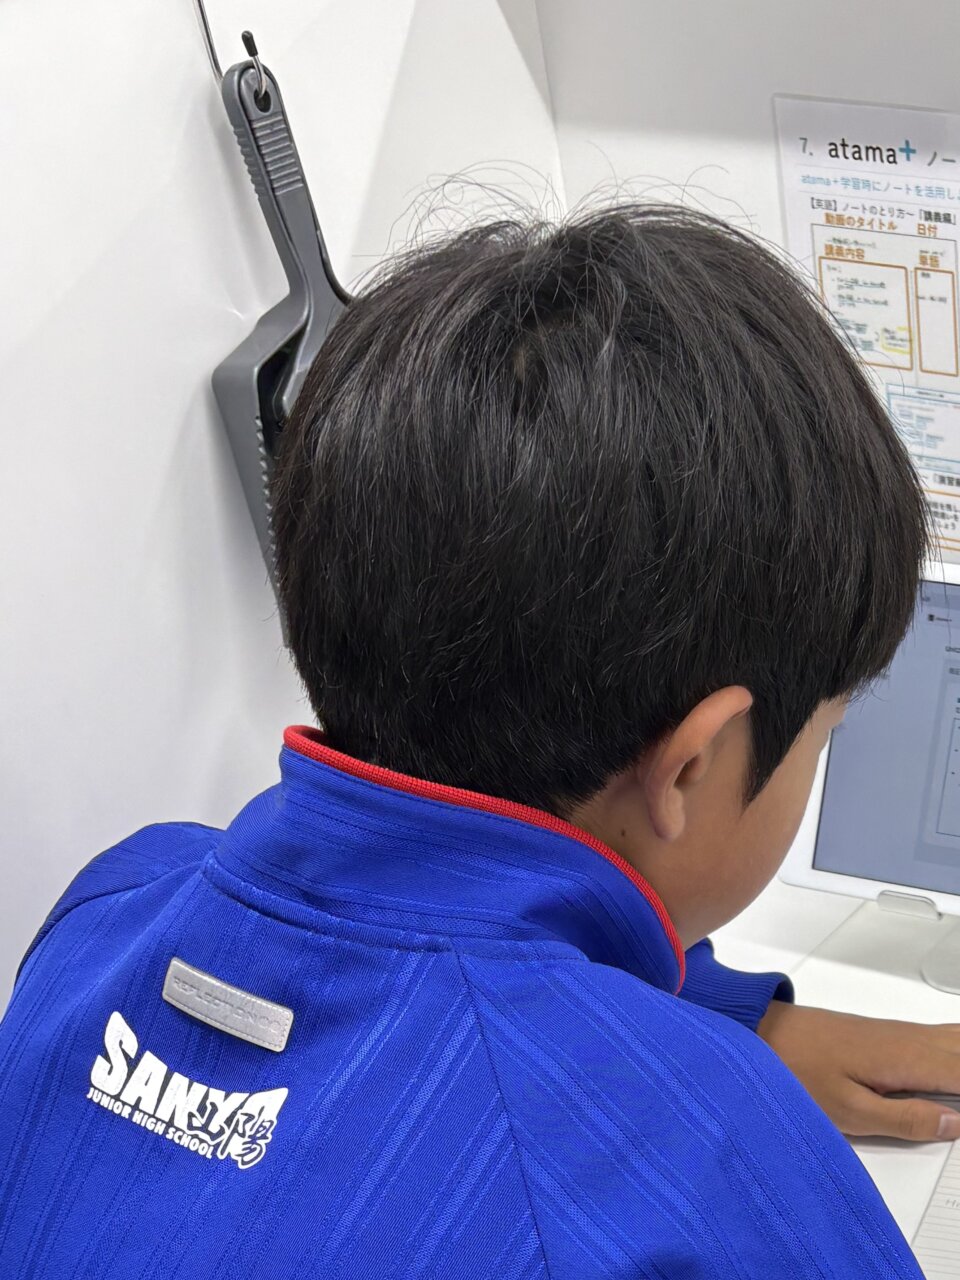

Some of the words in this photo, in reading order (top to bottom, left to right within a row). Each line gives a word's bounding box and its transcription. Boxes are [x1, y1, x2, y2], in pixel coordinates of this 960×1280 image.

[799, 137, 814, 156] 7.
[827, 137, 917, 165] atama+
[917, 223, 938, 238] 日付
[86, 1086, 132, 1119] JUNIOR
[132, 1108, 166, 1136] HIGH
[165, 1126, 214, 1160] SCHOOL
